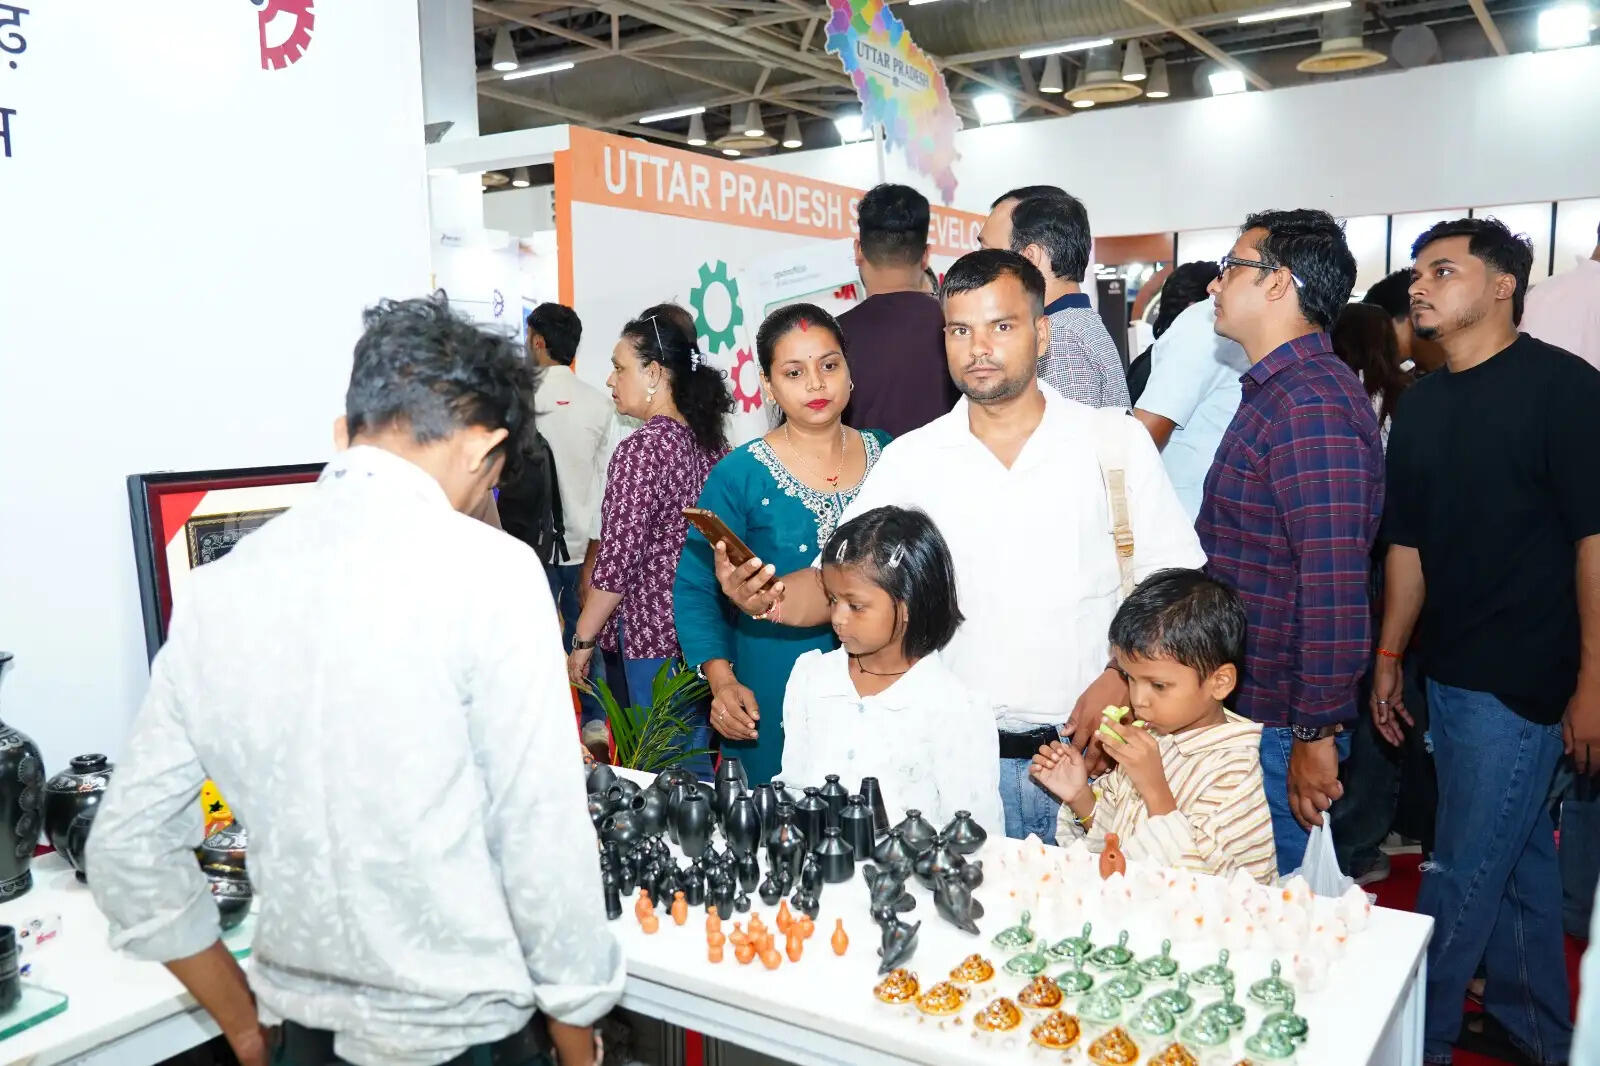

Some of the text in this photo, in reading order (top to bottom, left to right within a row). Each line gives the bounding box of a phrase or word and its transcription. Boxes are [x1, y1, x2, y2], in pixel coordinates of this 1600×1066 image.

[856, 39, 929, 89] UTTAR PRADESH
[603, 145, 713, 210] UTTAR
[719, 169, 843, 231] PRADESH
[928, 210, 984, 251] EVELO
